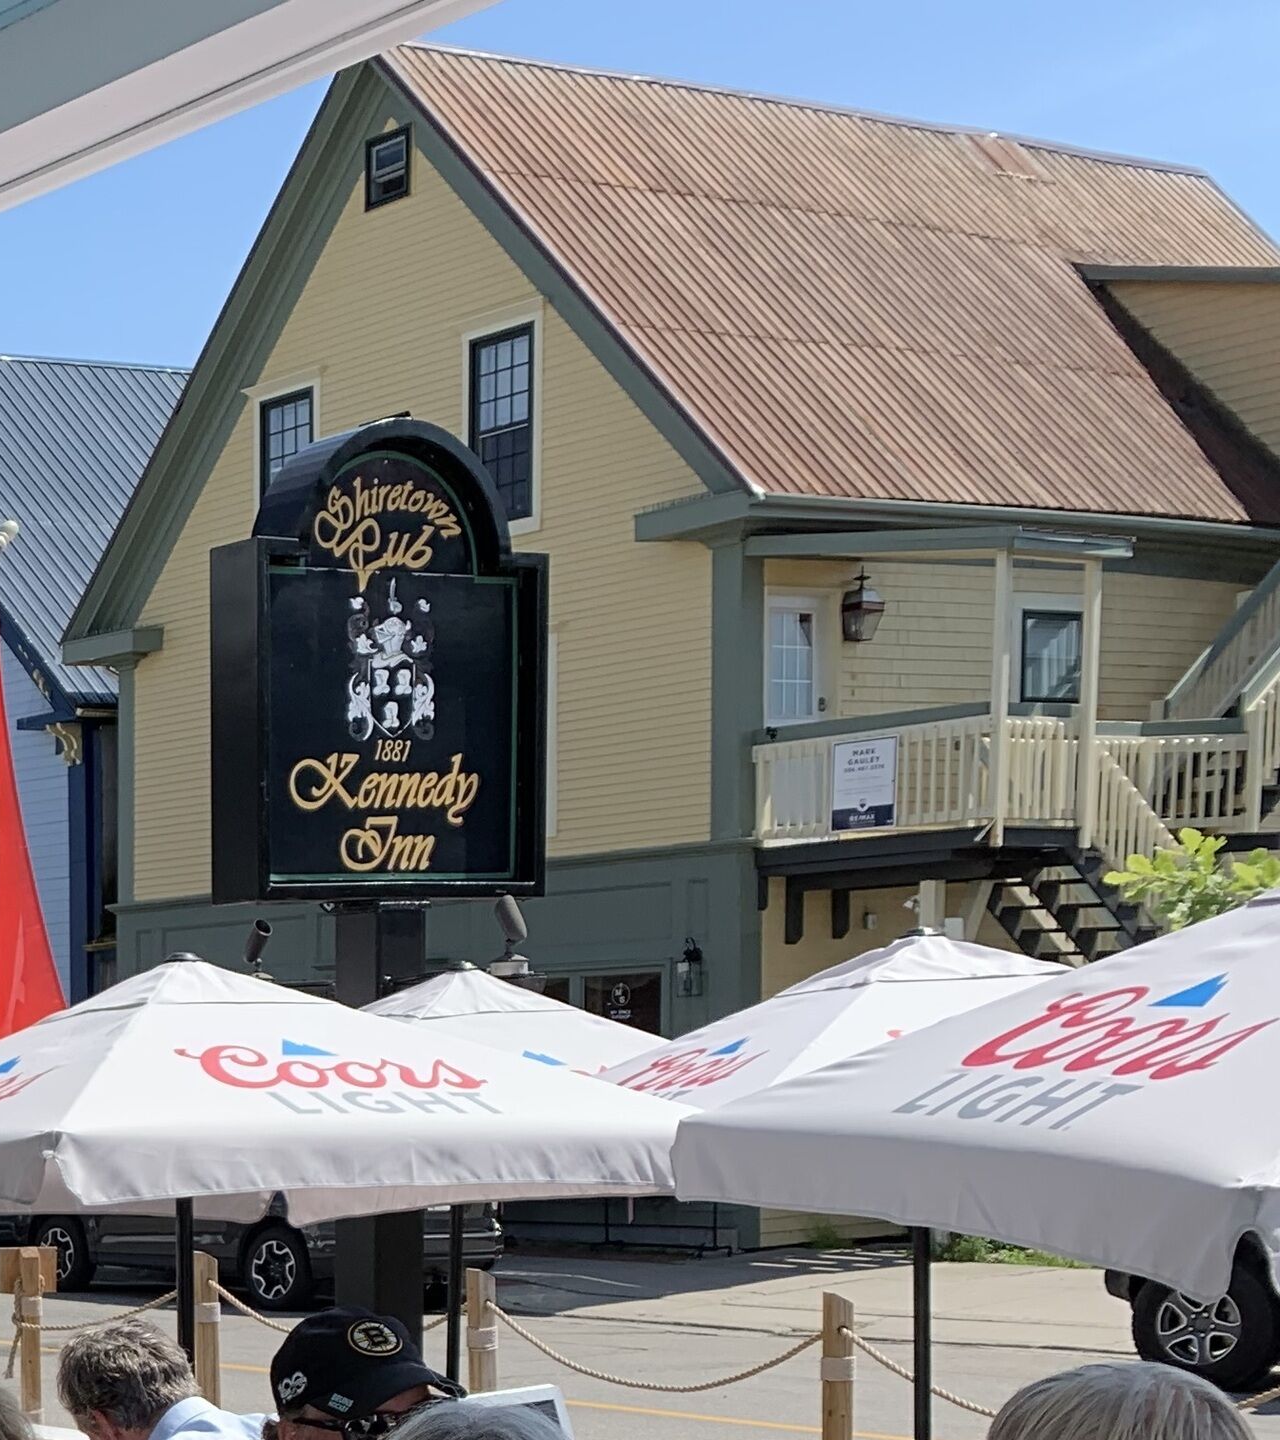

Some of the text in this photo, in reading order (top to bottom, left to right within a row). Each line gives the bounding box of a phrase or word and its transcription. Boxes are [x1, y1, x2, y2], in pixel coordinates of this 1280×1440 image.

[315, 476, 462, 549] Shiretown
[334, 518, 435, 593] Pub
[374, 739, 413, 762] 1881
[290, 752, 480, 825] Kennedy
[341, 815, 436, 871] Inn
[961, 985, 1280, 1080] Coors
[174, 1044, 489, 1089] Coors
[266, 1091, 503, 1114] LIGHT
[892, 1072, 1145, 1131] LIGHT
